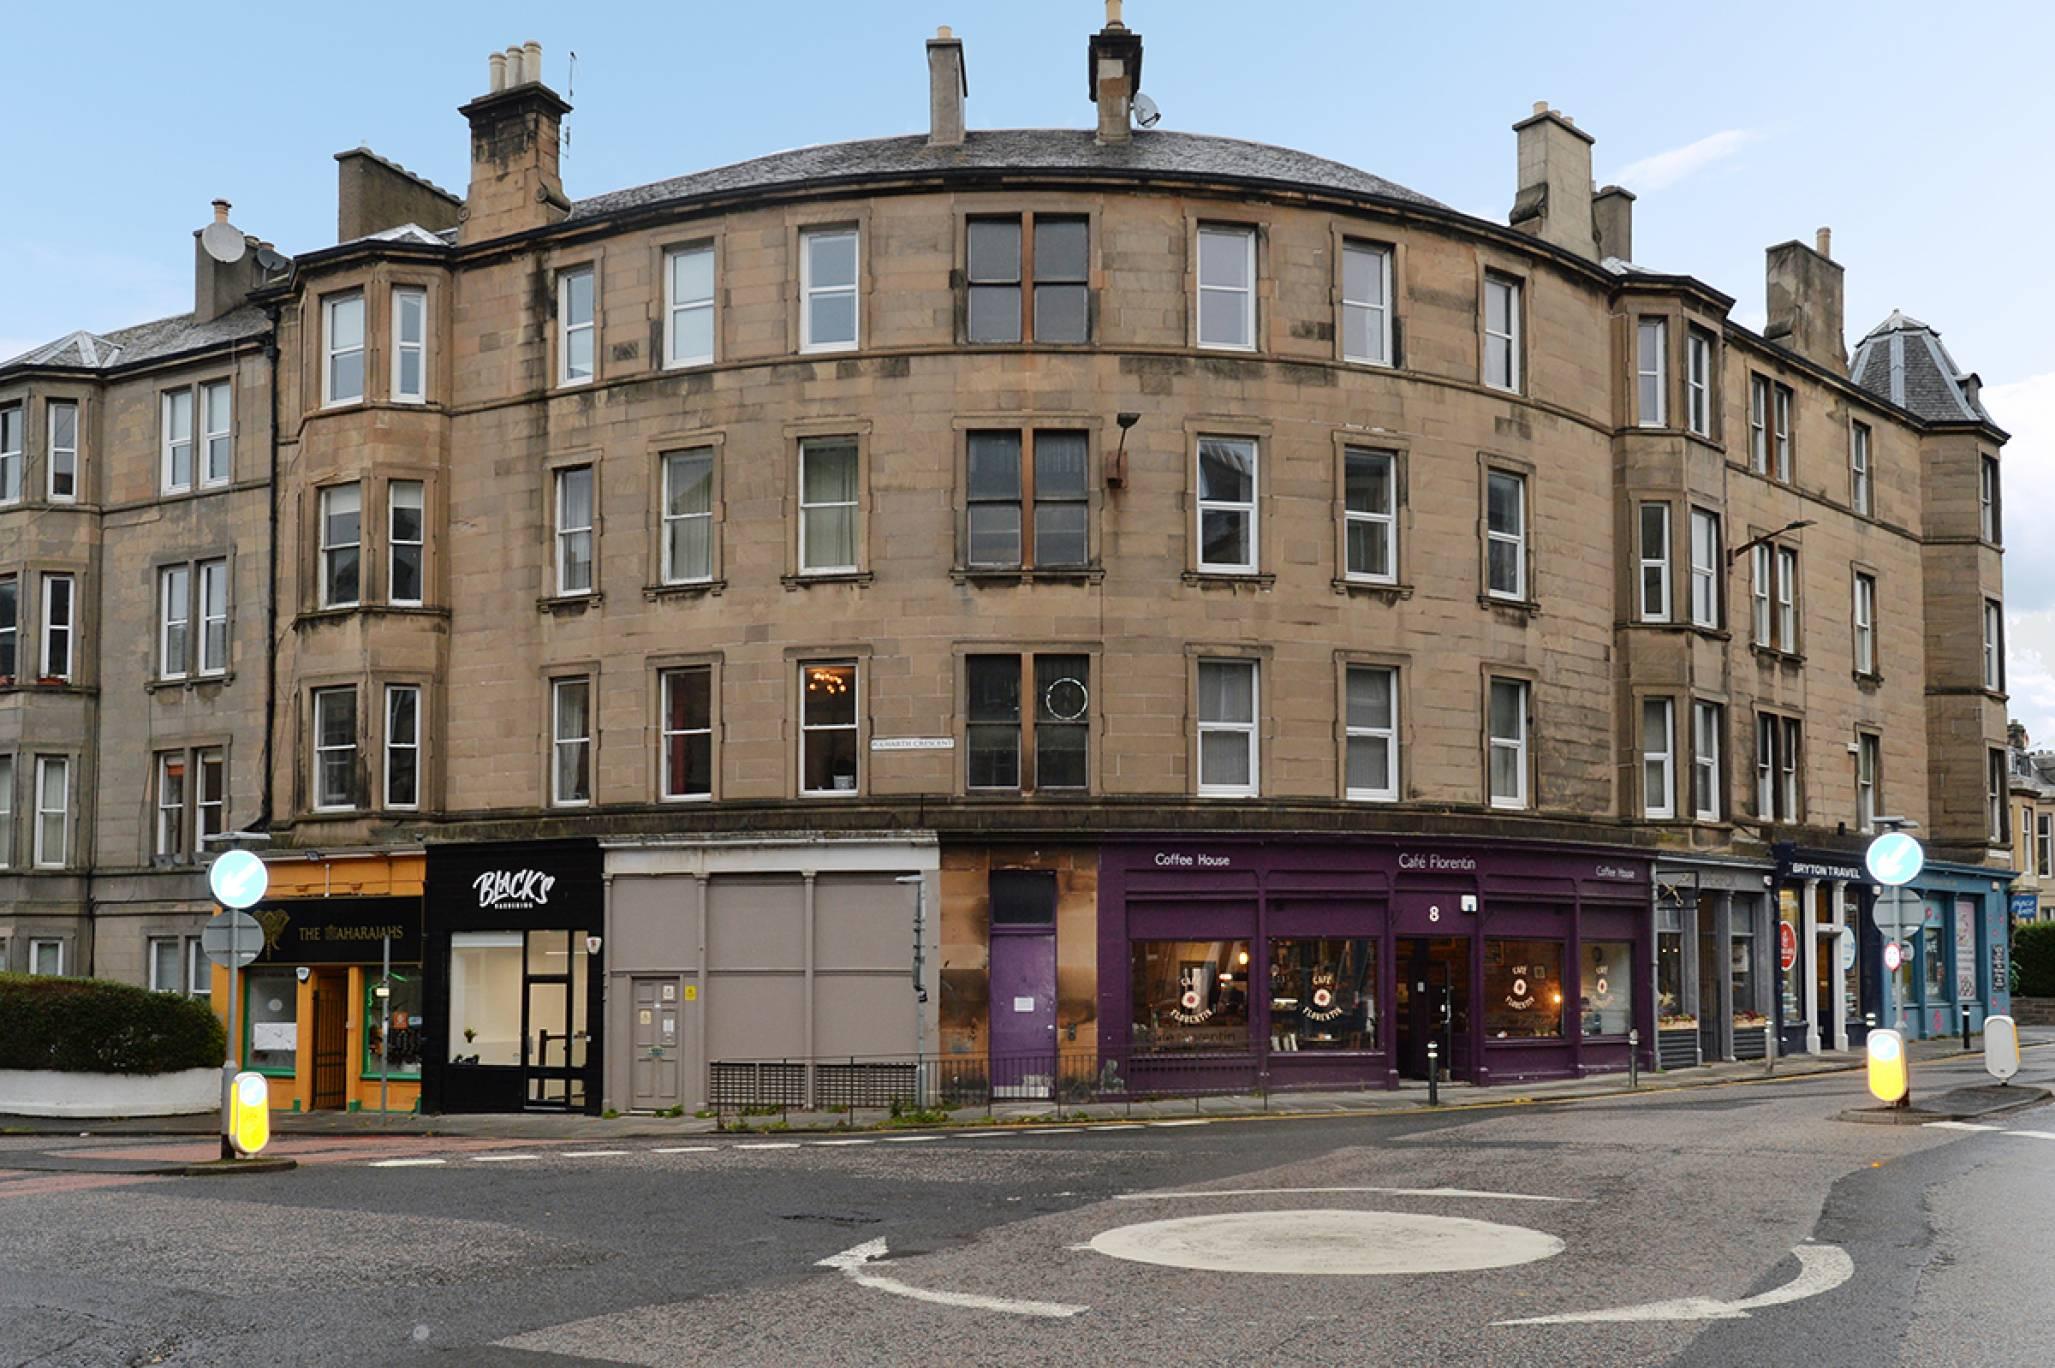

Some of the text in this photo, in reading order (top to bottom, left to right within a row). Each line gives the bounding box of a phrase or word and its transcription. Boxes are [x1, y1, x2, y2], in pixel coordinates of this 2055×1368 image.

[1155, 852, 1231, 866] Coffee House
[1399, 853, 1476, 869] Café Florentin
[1429, 905, 1440, 922] 8
[299, 927, 321, 941] THE
